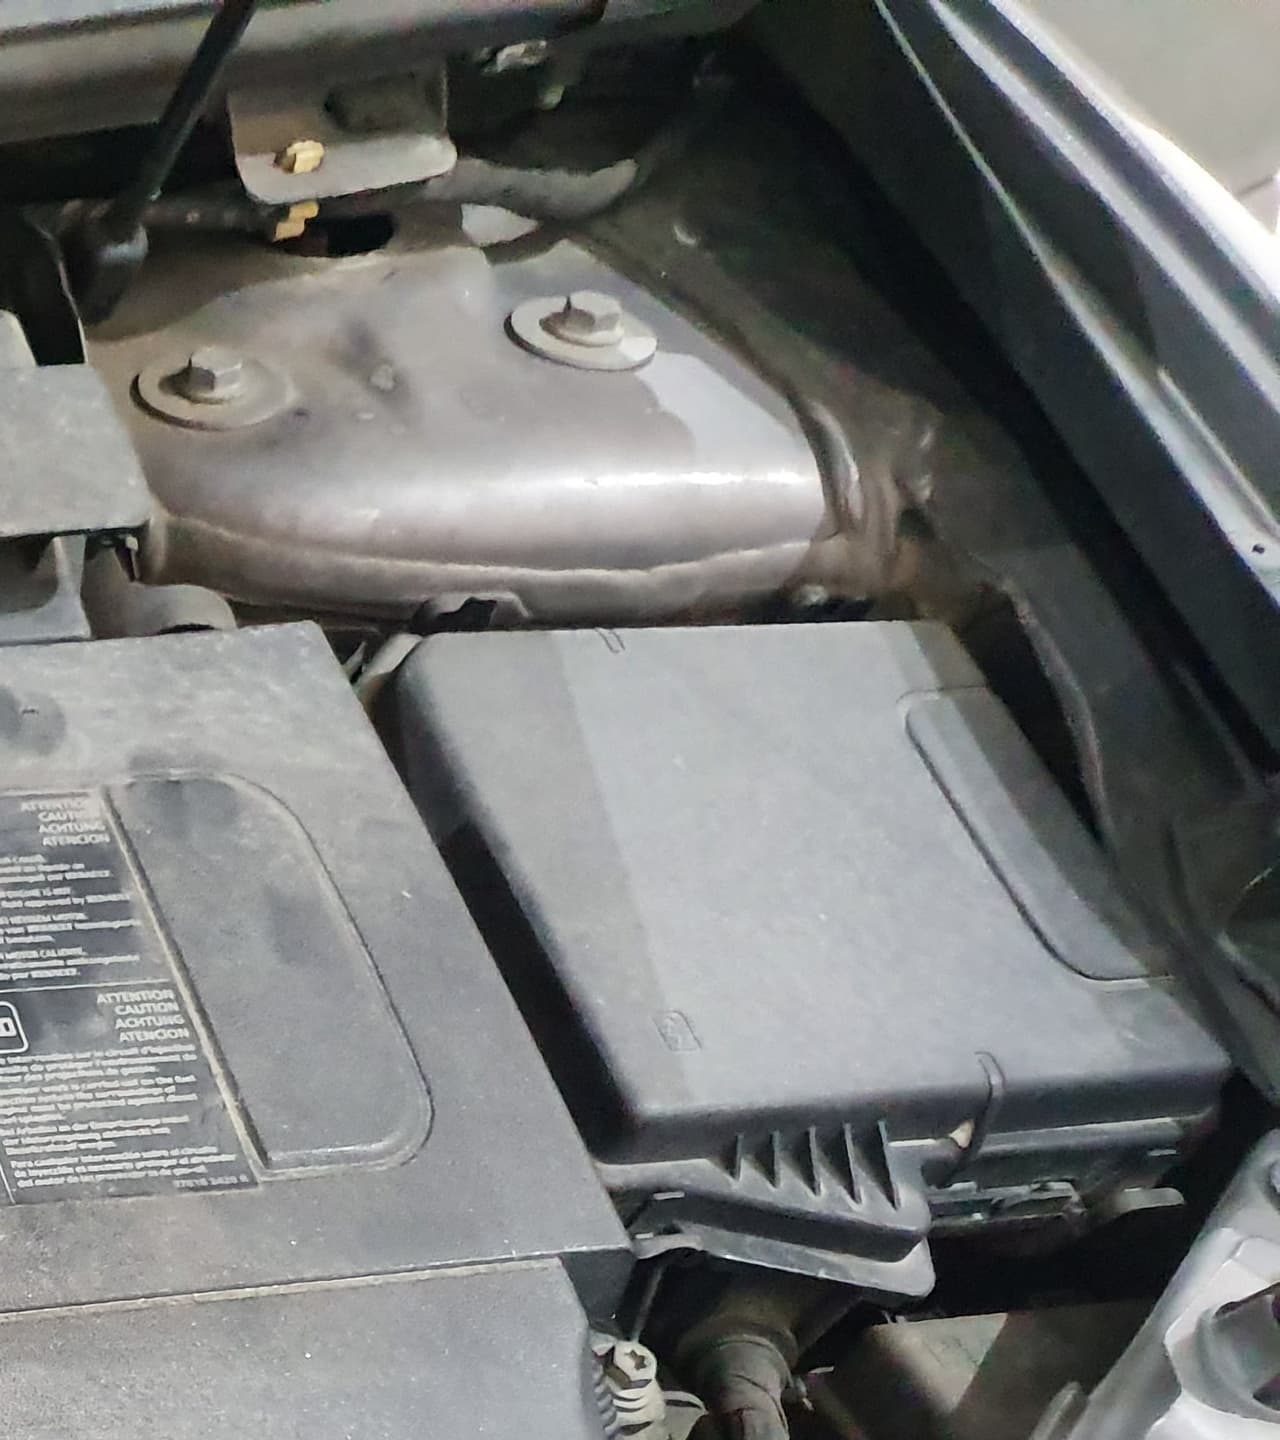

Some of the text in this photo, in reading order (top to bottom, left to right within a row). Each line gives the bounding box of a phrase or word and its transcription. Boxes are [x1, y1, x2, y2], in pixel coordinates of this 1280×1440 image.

[95, 989, 173, 1003] ATTENTION
[114, 1002, 178, 1014] CAUTION
[113, 1014, 184, 1028] ACHTUNG
